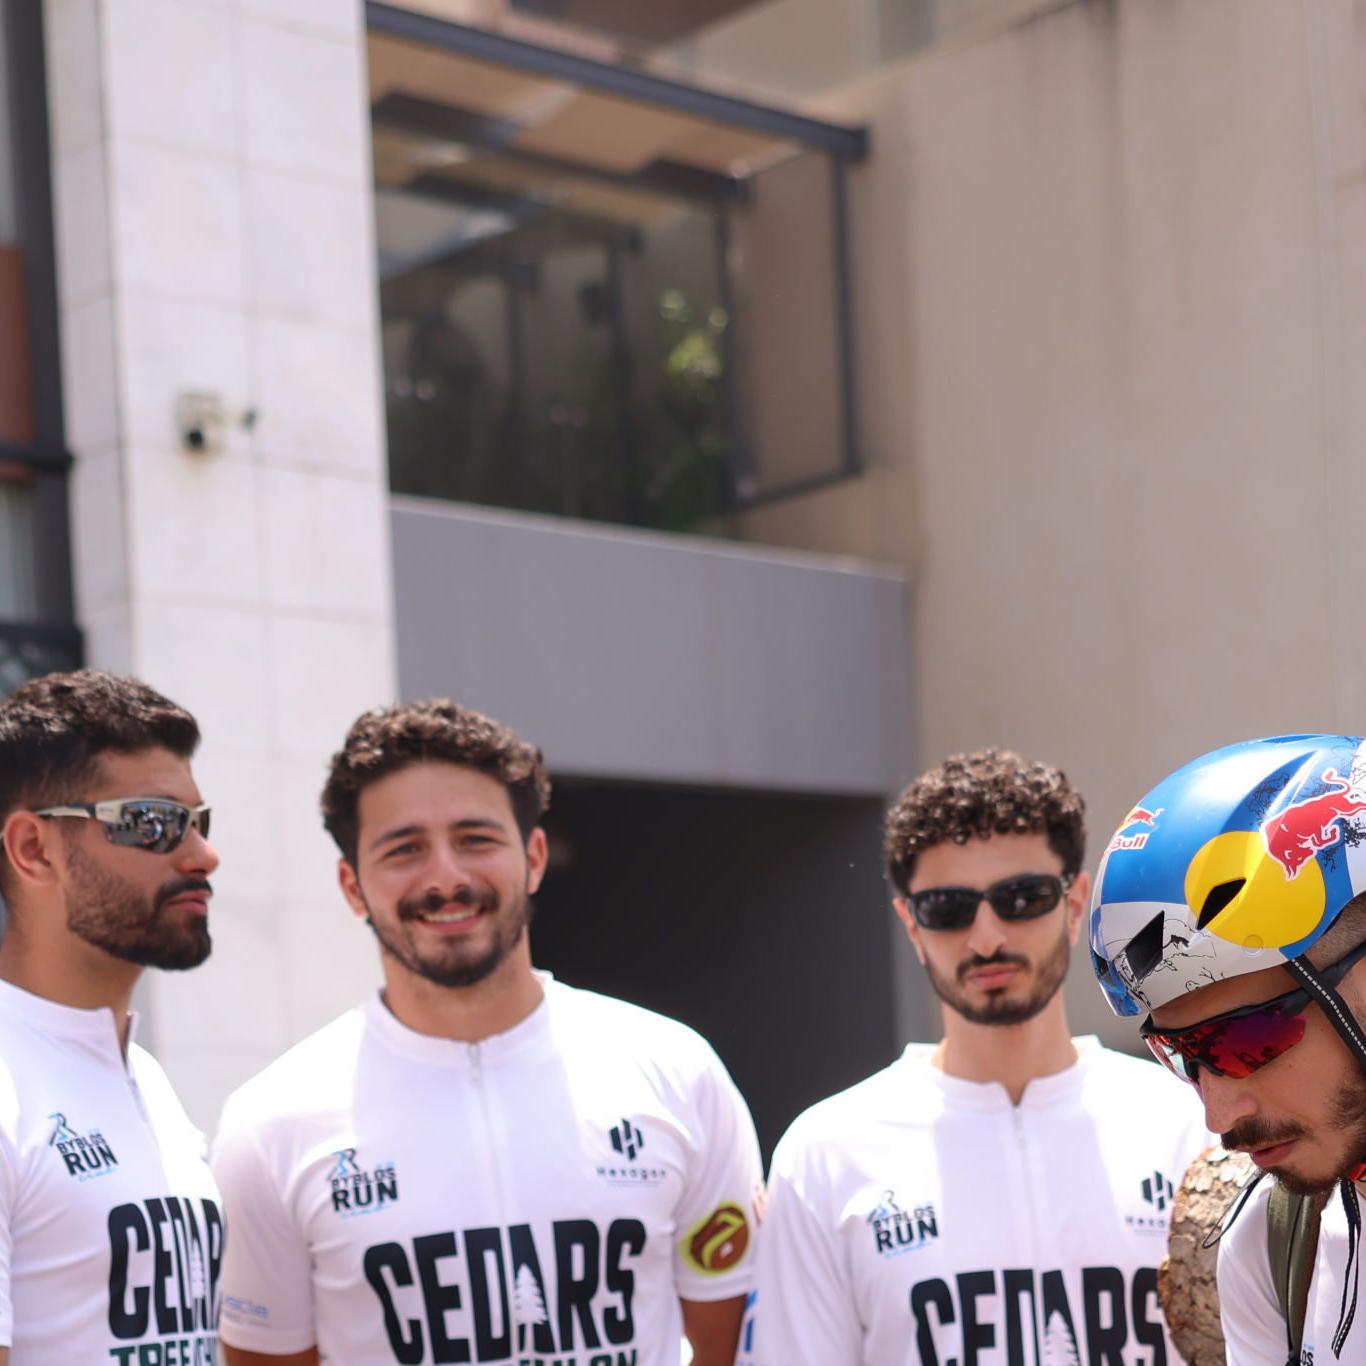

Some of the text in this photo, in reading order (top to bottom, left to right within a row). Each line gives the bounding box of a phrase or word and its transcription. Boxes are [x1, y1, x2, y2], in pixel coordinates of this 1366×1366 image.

[56, 1132, 106, 1155] BYBLOS
[62, 1142, 119, 1176] RUN
[332, 1179, 399, 1213] RUN
[876, 1217, 939, 1254] RUN
[363, 1218, 647, 1366] CEDARS
